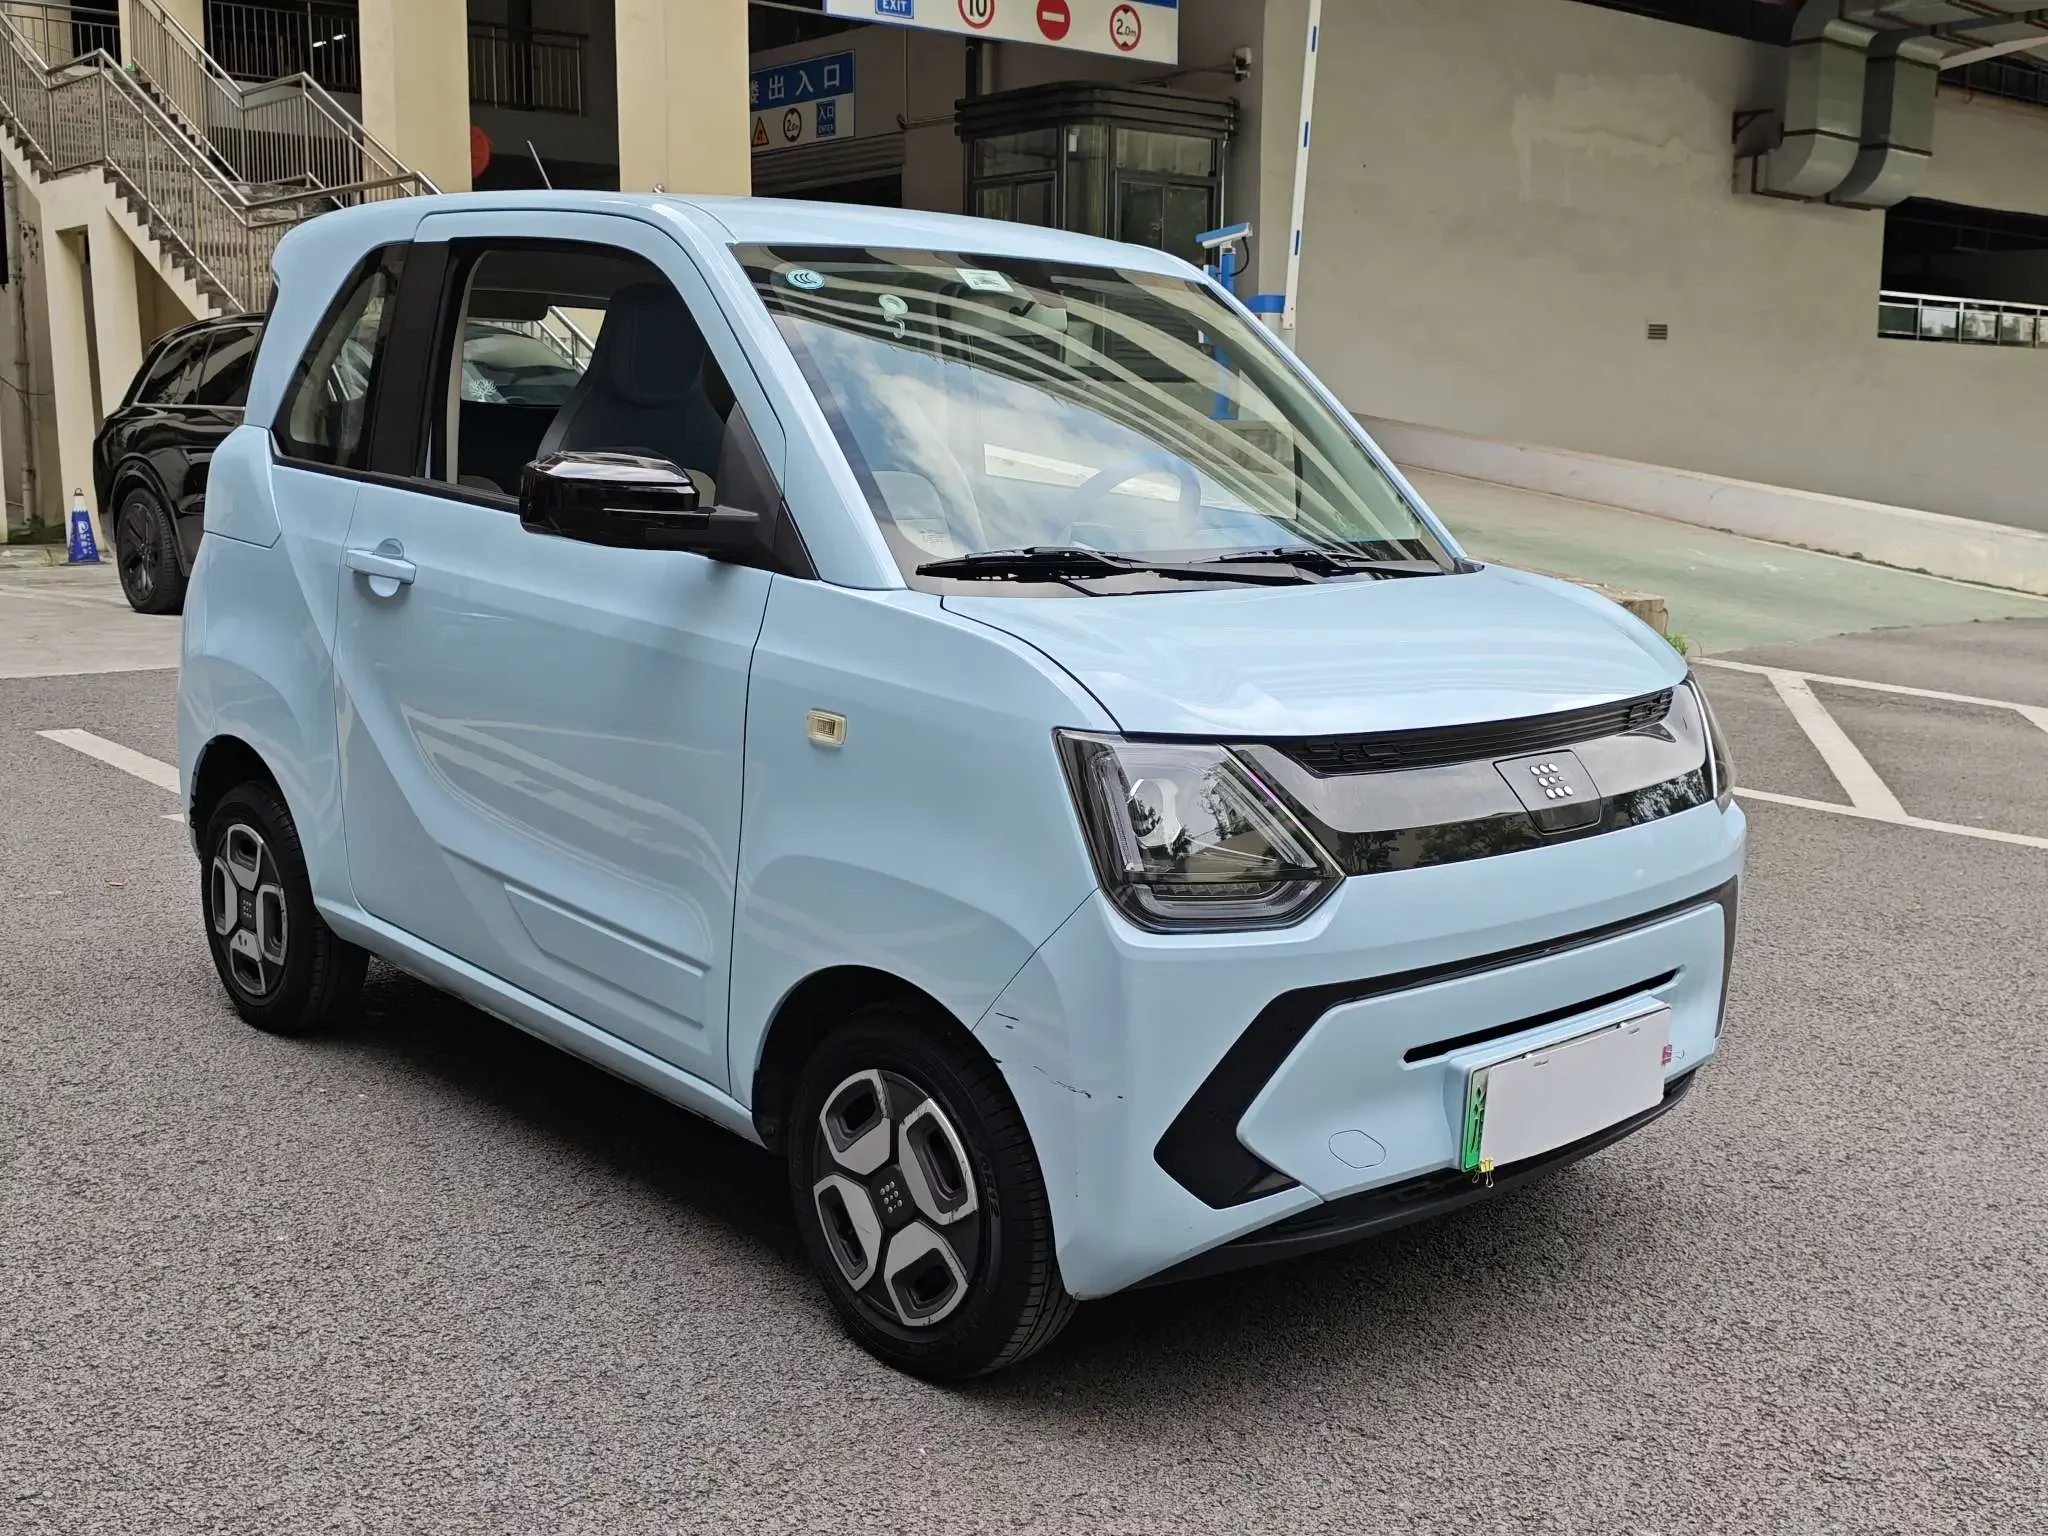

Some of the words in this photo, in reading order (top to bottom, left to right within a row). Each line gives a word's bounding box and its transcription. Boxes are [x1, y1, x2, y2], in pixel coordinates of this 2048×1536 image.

[883, 0, 907, 12] EXIT
[969, 0, 988, 17] 10
[1116, 19, 1137, 37] 2.0m
[819, 106, 834, 121] 入口
